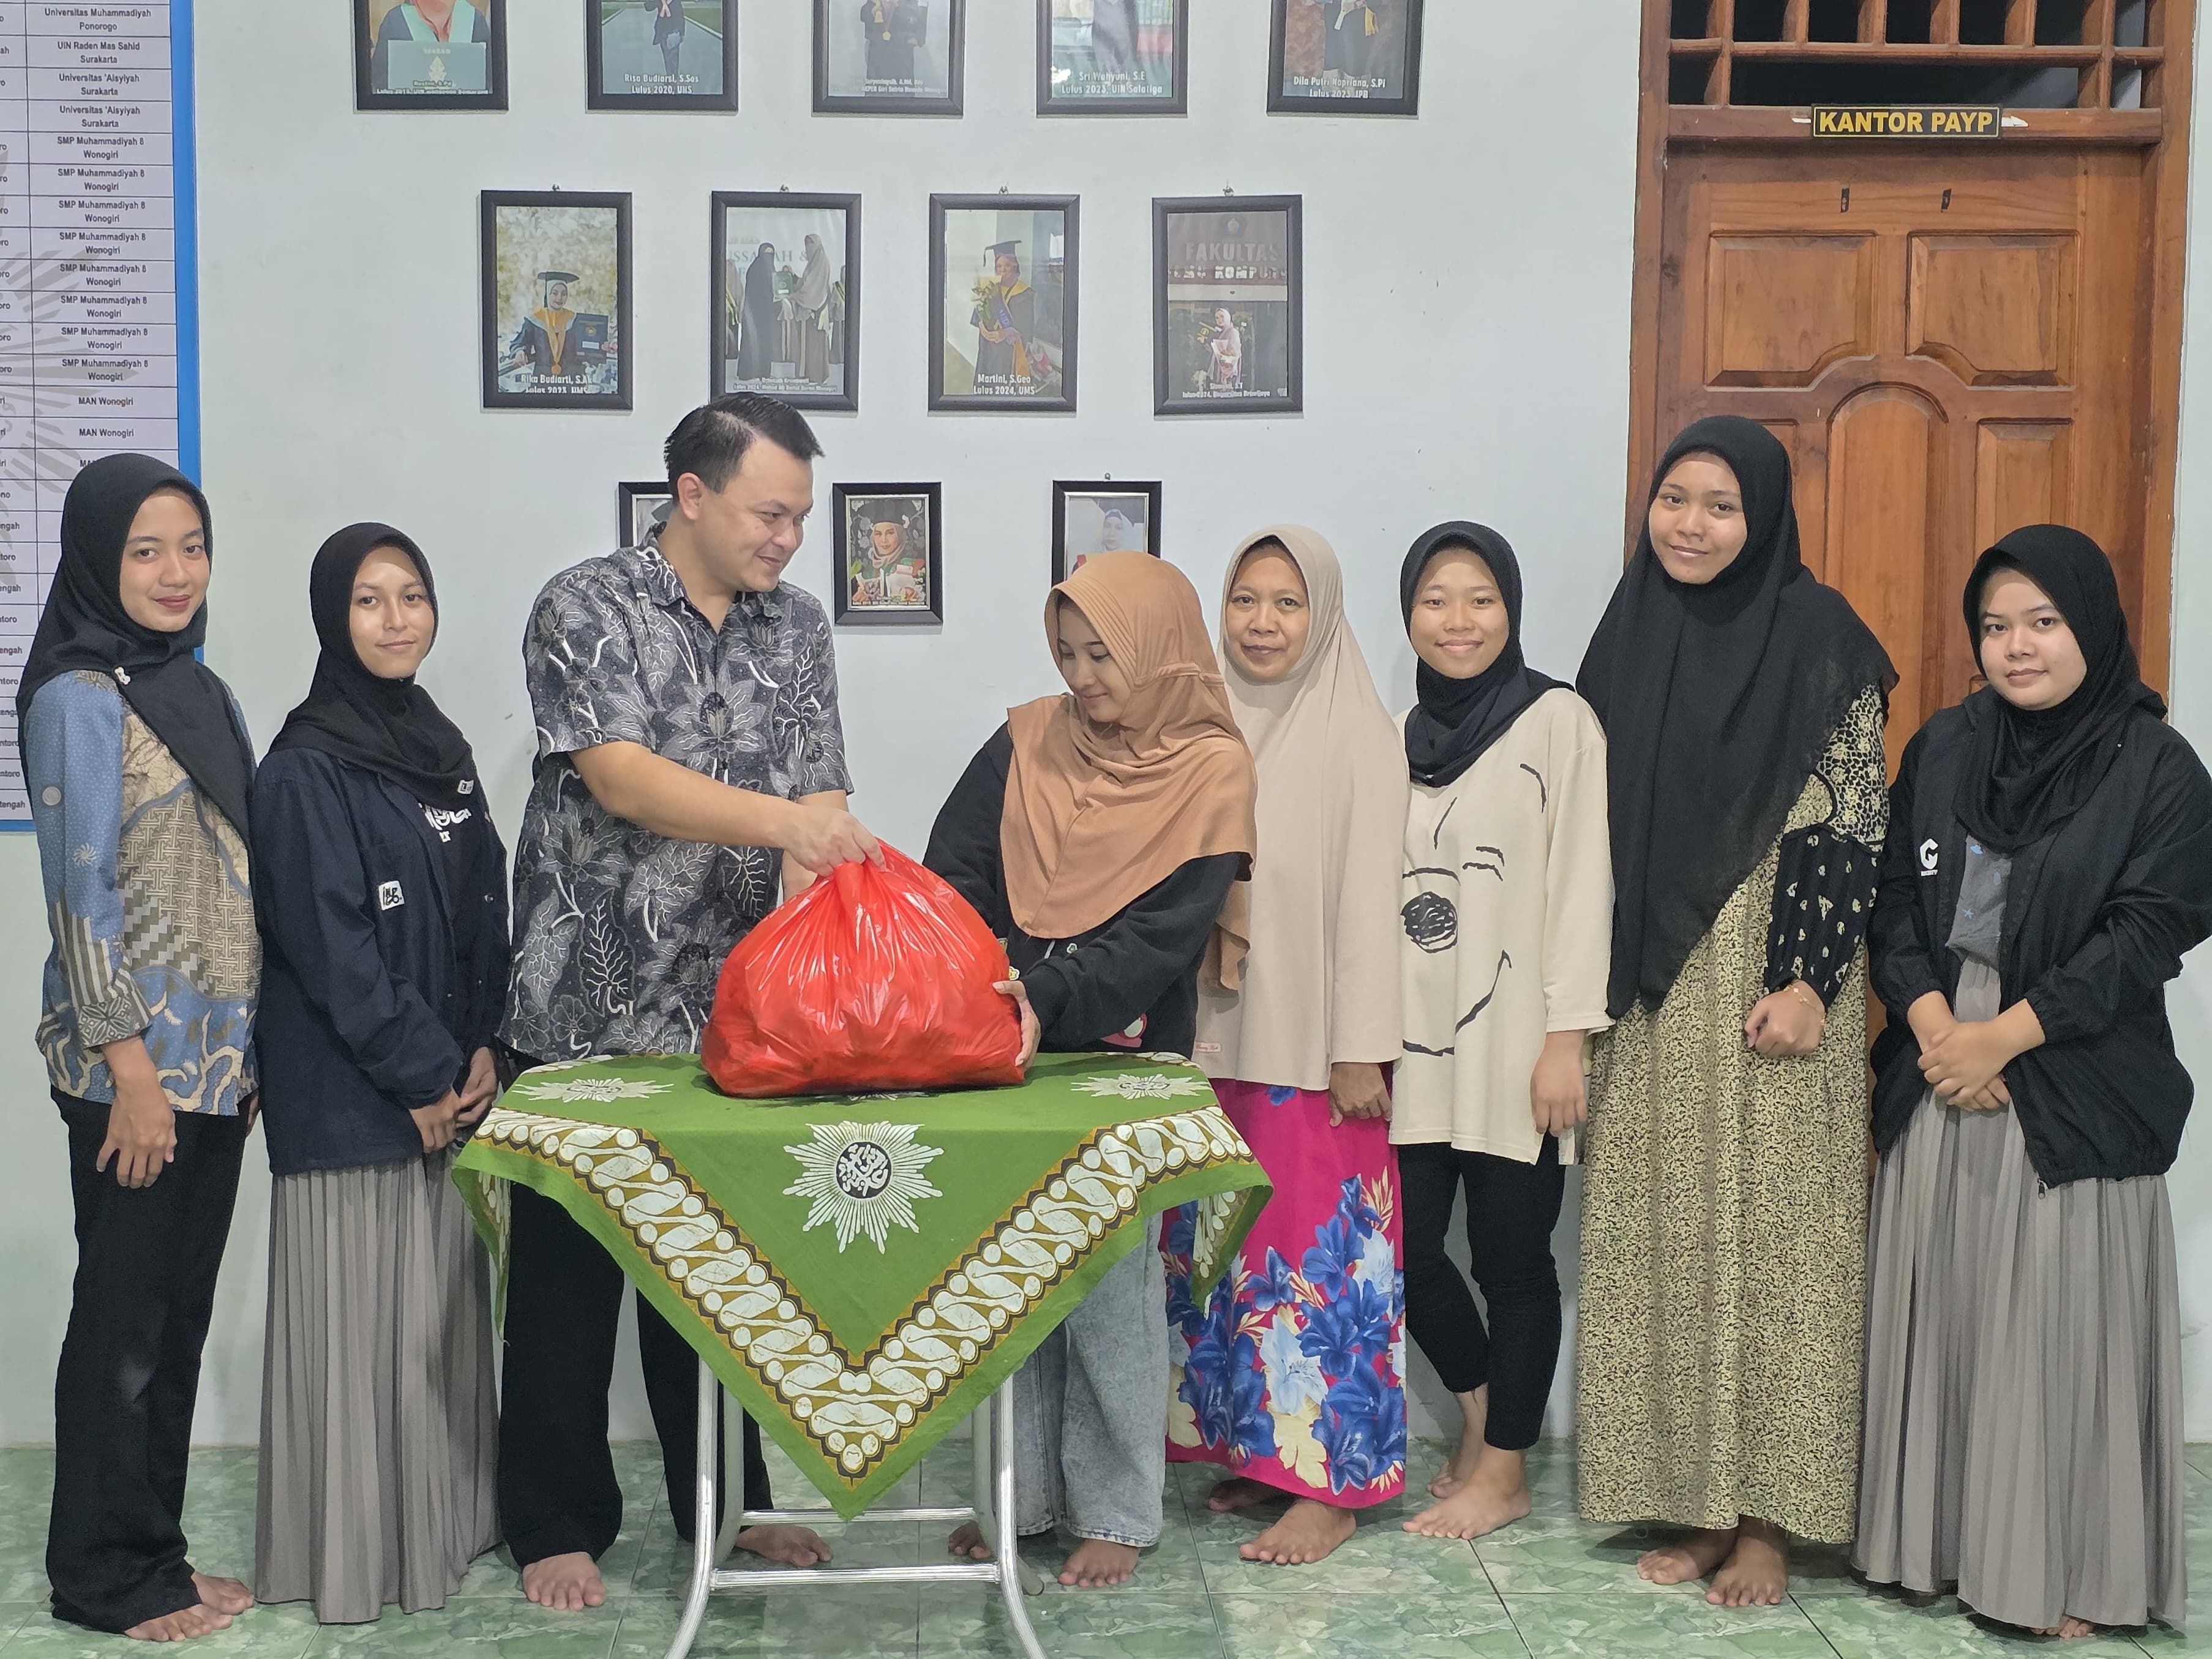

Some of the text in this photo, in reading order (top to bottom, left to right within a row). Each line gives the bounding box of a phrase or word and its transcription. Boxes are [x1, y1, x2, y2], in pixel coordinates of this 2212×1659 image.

[45, 8, 151, 19] Universitas Muhammadiyah
[80, 22, 117, 32] Ponorogo
[58, 41, 71, 50] UIN
[118, 42, 140, 50] Sahid
[80, 54, 118, 63] Surakarta
[59, 73, 102, 81] Universitas
[1079, 72, 1090, 81] Sri
[1294, 76, 1309, 85] Dila
[1311, 78, 1330, 86] Putri
[632, 85, 651, 94] Lulus
[1062, 85, 1083, 94] Lulus
[1128, 84, 1163, 95] Salatiga
[59, 105, 103, 114] Universitas
[81, 119, 119, 127] Surakarta
[1820, 111, 1993, 132] KANTOR PAYP
[77, 137, 137, 147] Muhammadiyah
[83, 150, 118, 160] Wonogiri
[78, 168, 138, 179] Muhammadiyah
[84, 182, 119, 192] Wonogiri
[78, 200, 138, 211] Muhammadiyah
[84, 214, 119, 224] Wonogiri
[79, 232, 139, 242] Muhammadiyah
[86, 245, 120, 256] Wonogiri
[1185, 242, 1277, 261] FAKULTAS
[80, 264, 140, 274] Muhammadiyah
[86, 277, 121, 288] Wonogiri
[80, 296, 140, 306] Muhammadiyah
[87, 309, 121, 319] Wonogiri
[81, 328, 141, 337] Muhammadiyah
[88, 341, 122, 351] Wonogiri
[81, 359, 141, 369] Muhammadiyah
[88, 372, 122, 382] Wonogiri
[521, 374, 538, 383] Rika
[540, 374, 574, 384] Budiarti,
[978, 373, 1031, 384] Martini, S.Geo
[973, 385, 1035, 395] Lulus 2024, UMS
[99, 397, 133, 407] Wonogiri
[99, 429, 133, 438] Wonogiri
